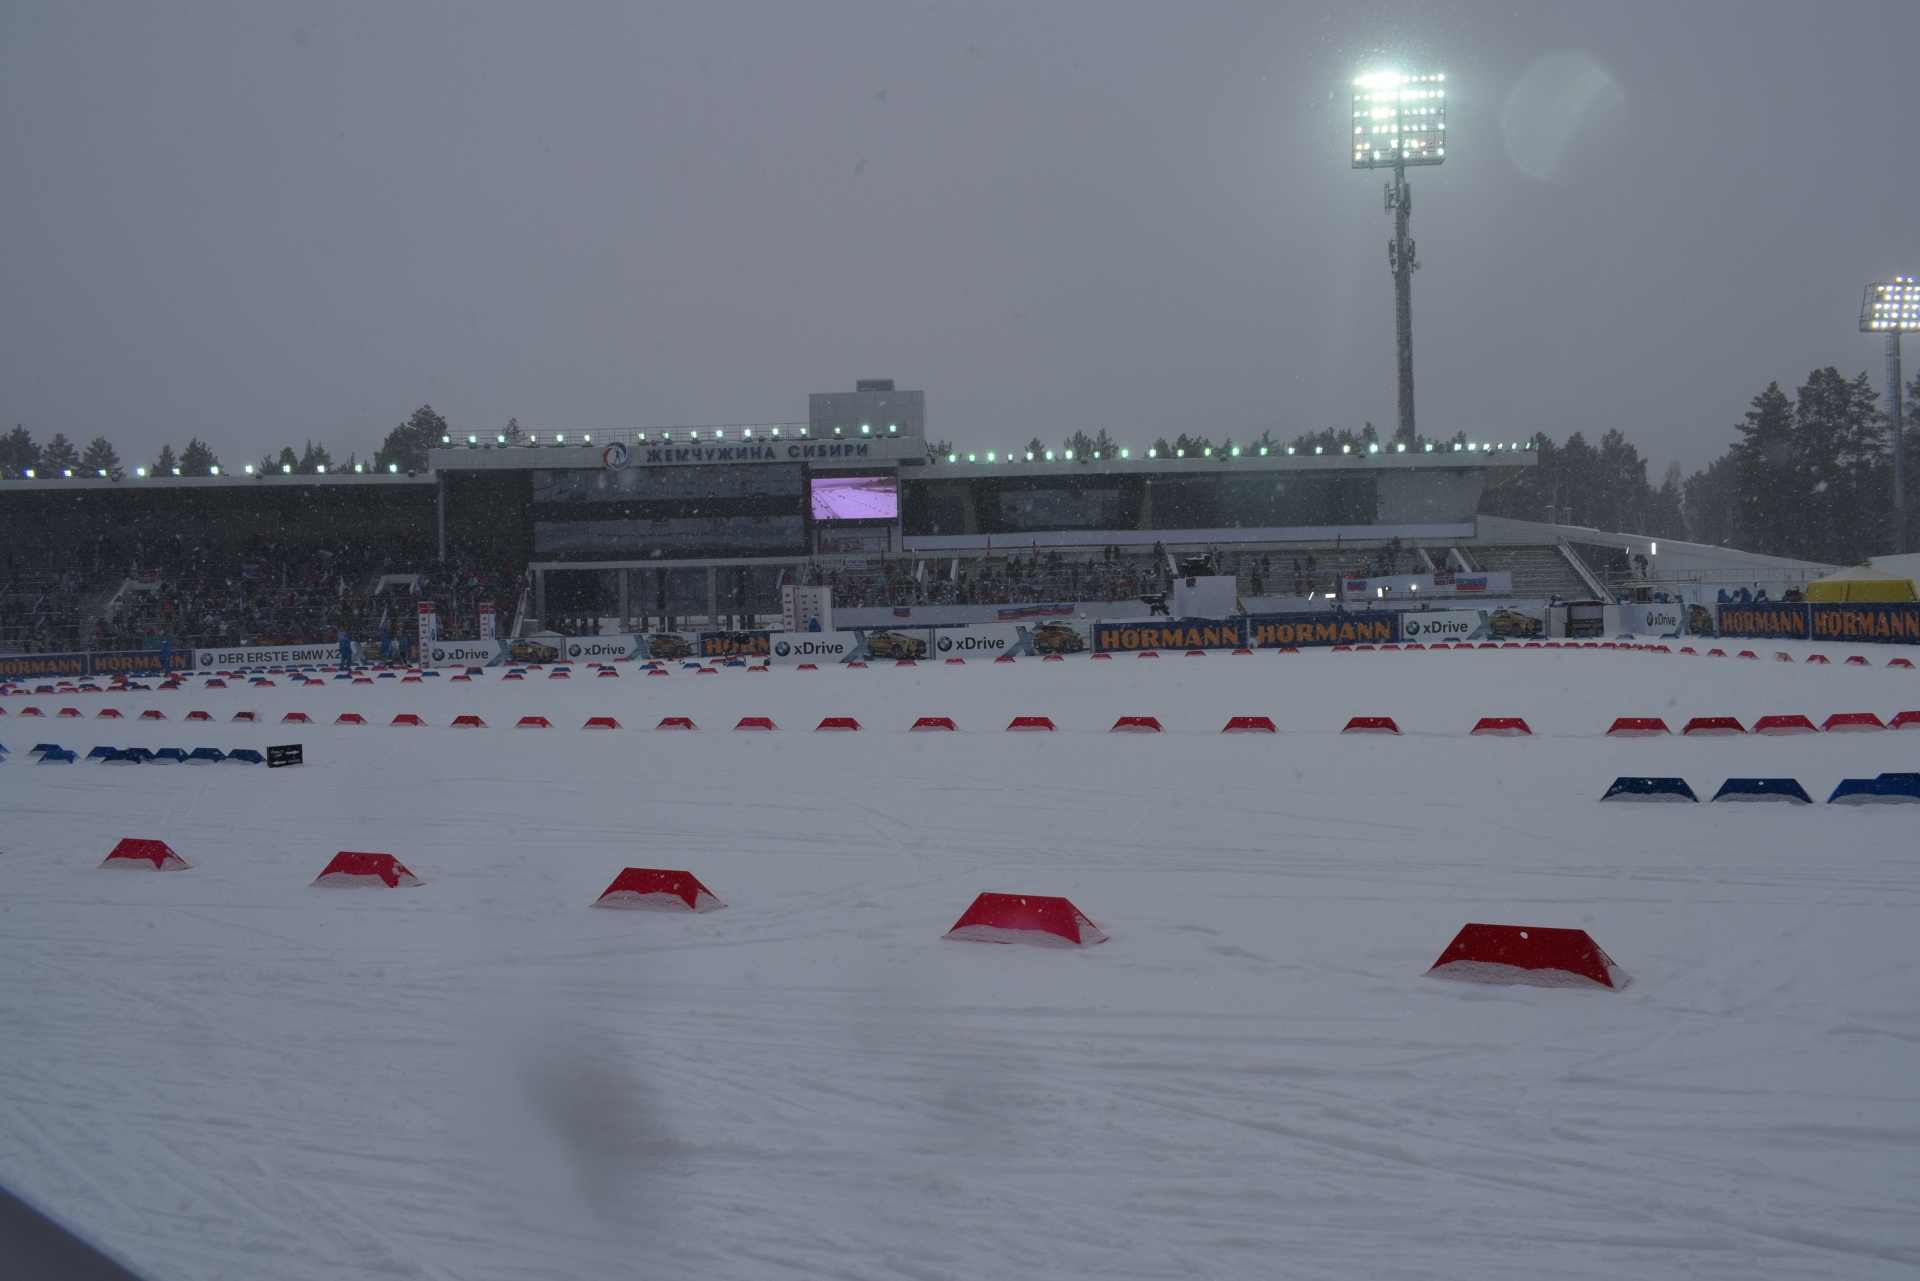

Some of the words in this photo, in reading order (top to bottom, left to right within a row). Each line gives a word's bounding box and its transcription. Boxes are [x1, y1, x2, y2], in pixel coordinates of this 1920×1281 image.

[646, 446, 776, 463] ЖЕМЧУЖИНА
[788, 443, 869, 458] СИБИРИ
[1654, 612, 1676, 626] xDrive
[1814, 609, 1920, 637] HÖRMANN
[1257, 620, 1390, 644] HÖRMANN
[1423, 621, 1468, 634] xDrive
[956, 636, 1004, 650] xDrive
[1101, 626, 1239, 649] HÖRMANN
[448, 649, 489, 660] xDrive
[584, 644, 626, 656] xDrive
[794, 641, 843, 655] xDrive
[94, 654, 187, 671] HÖRMAN
[219, 653, 245, 664] DER
[247, 651, 289, 662] ERSTE
[293, 649, 324, 661] BMW
[326, 649, 341, 659] X2
